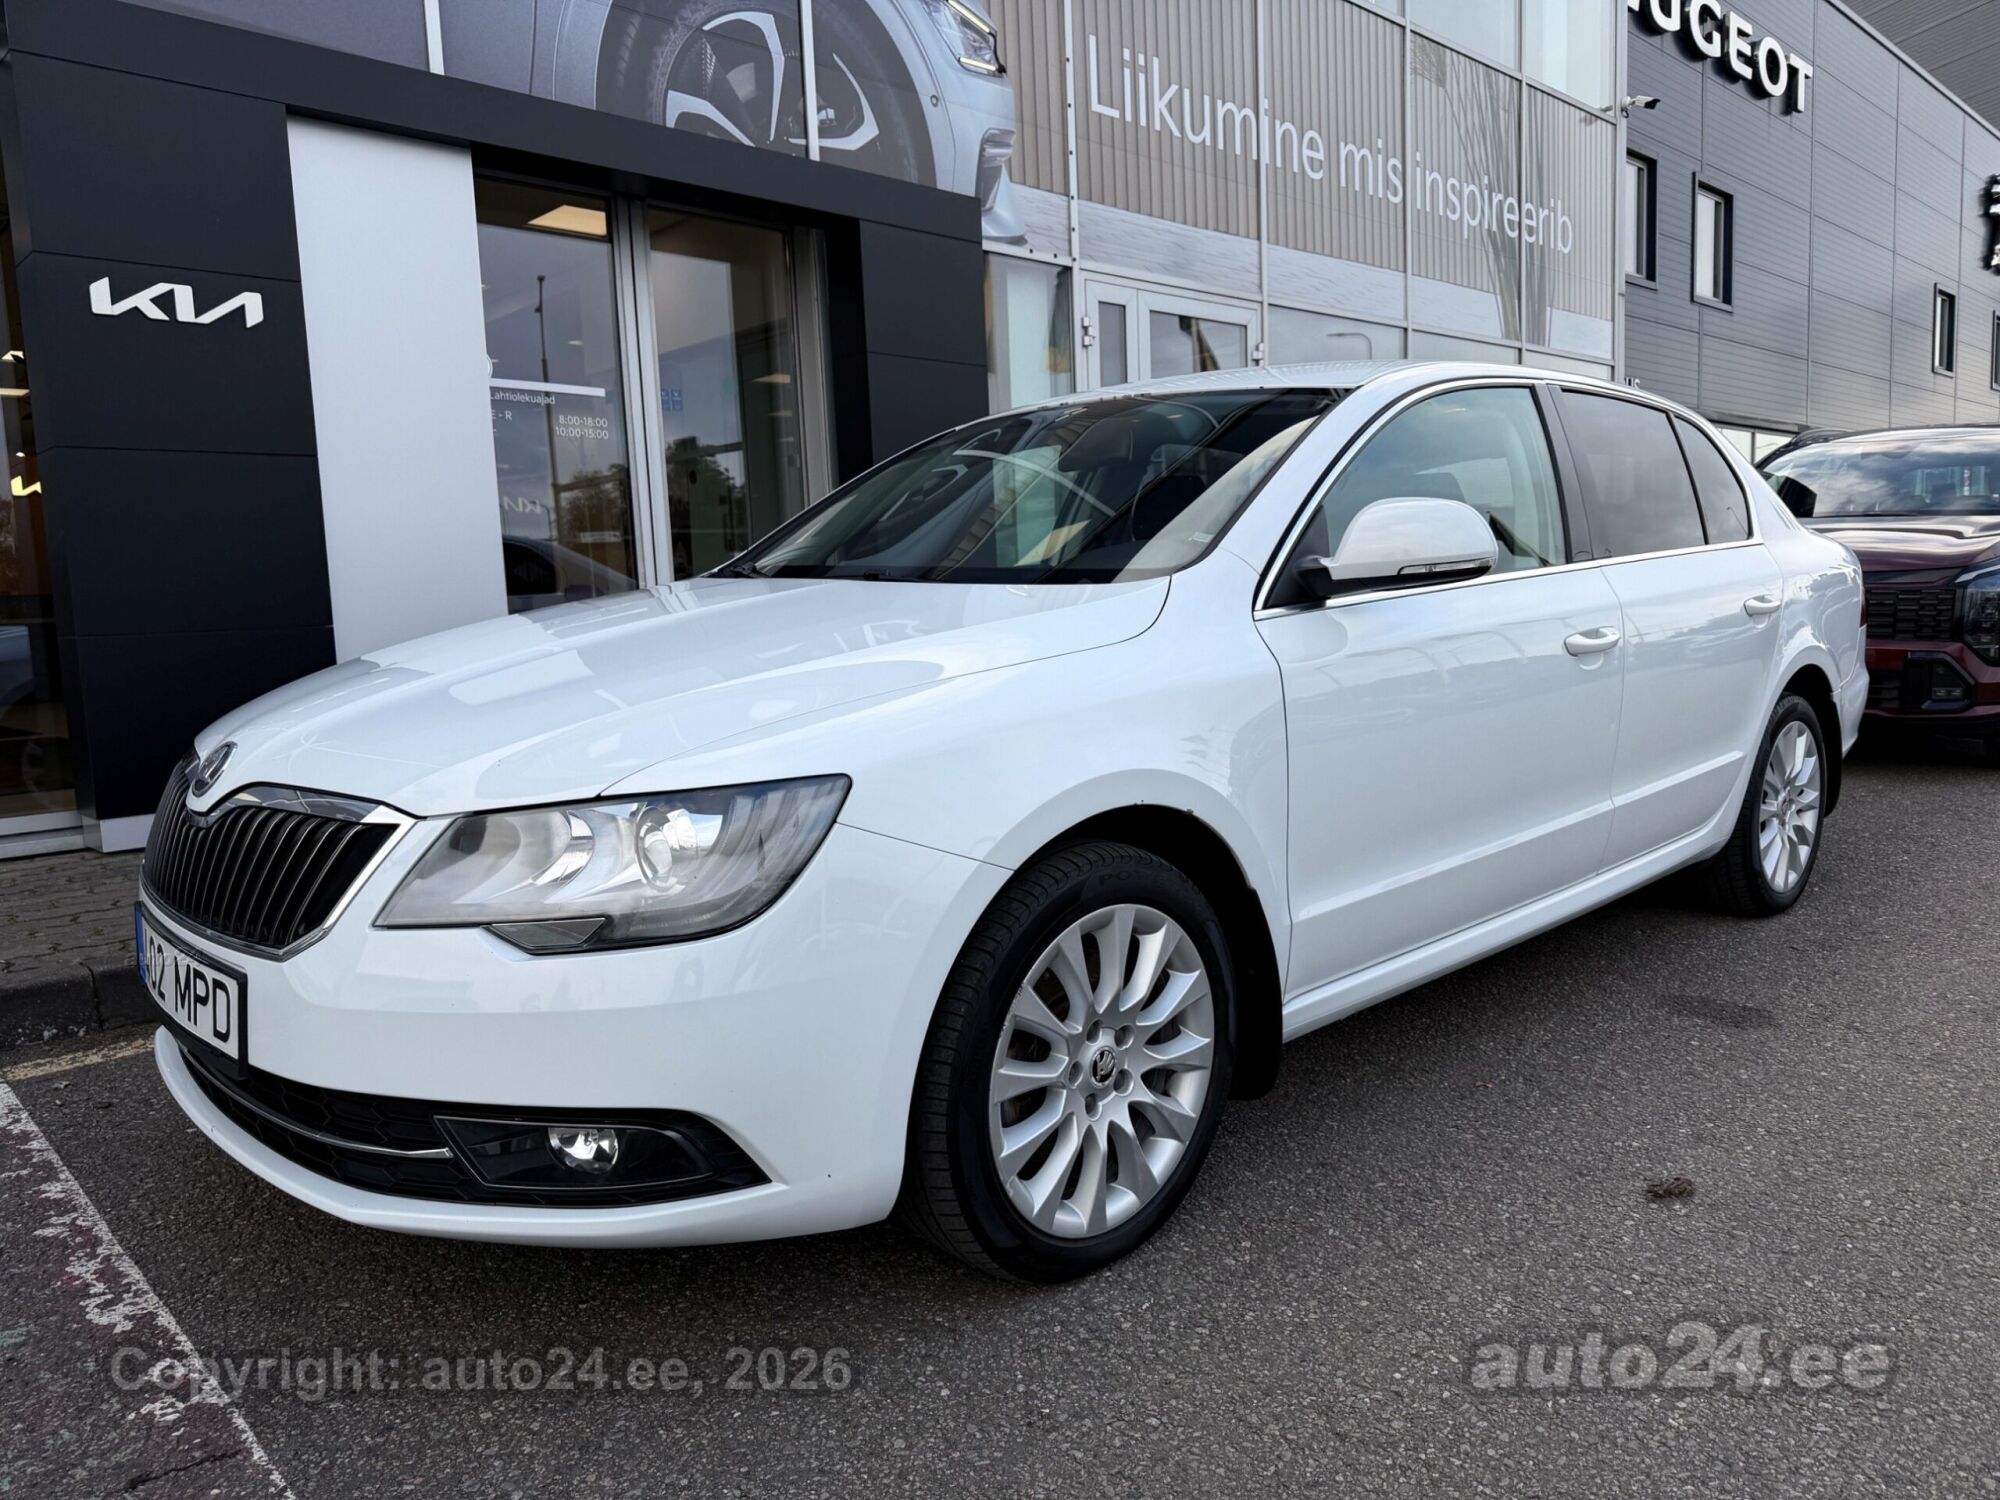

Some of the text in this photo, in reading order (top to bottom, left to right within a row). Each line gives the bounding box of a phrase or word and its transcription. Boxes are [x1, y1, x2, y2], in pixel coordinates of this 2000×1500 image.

[1628, 0, 1813, 113] UGEOT
[1089, 34, 1573, 255] Liikumine mis inspireerib
[89, 276, 264, 329] KIA
[491, 391, 556, 407] ahtiolekuajad
[559, 415, 608, 428] 8:00-18:00
[555, 426, 609, 440] 10:00-15:00
[174, 954, 231, 1043] MPD
